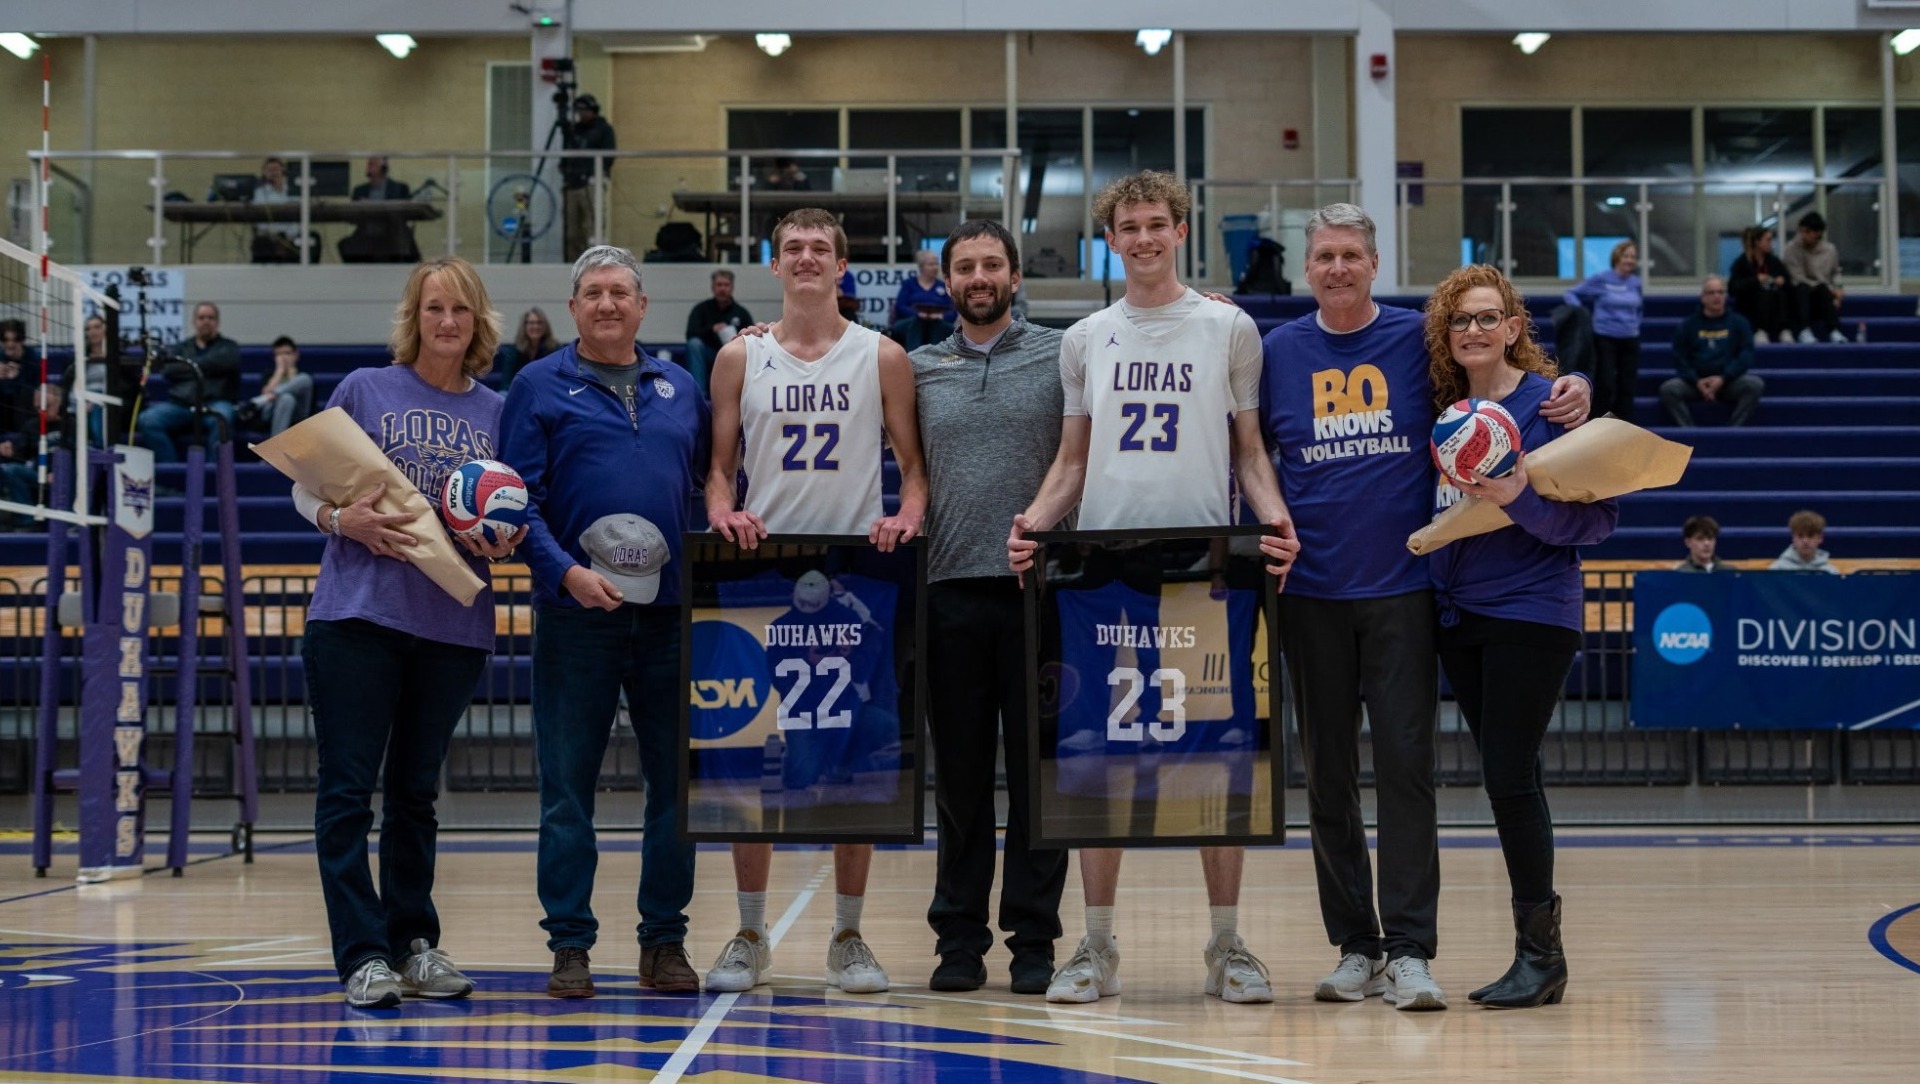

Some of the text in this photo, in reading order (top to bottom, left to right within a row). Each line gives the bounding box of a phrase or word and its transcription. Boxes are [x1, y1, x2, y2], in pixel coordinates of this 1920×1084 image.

[1113, 361, 1193, 392] LORAS
[1312, 364, 1389, 418] BO
[772, 384, 850, 412] LORAS
[381, 409, 493, 461] LORAS
[1119, 403, 1180, 452] 23
[1313, 409, 1394, 441] KNOWS
[782, 423, 840, 471] 22
[1301, 436, 1411, 463] VOLLEYBALL
[450, 478, 460, 509] NCAA
[764, 624, 862, 647] DUHAWKS
[1096, 623, 1196, 648] DUHAWKS
[1659, 632, 1710, 649] NCAA
[1737, 618, 1916, 651] DIVISION
[1738, 654, 1809, 667] DISCOVER
[1821, 655, 1882, 667] DEVELOP
[114, 547, 146, 857] DUHAWKS
[775, 656, 852, 730] 22
[1107, 667, 1186, 742] 23
